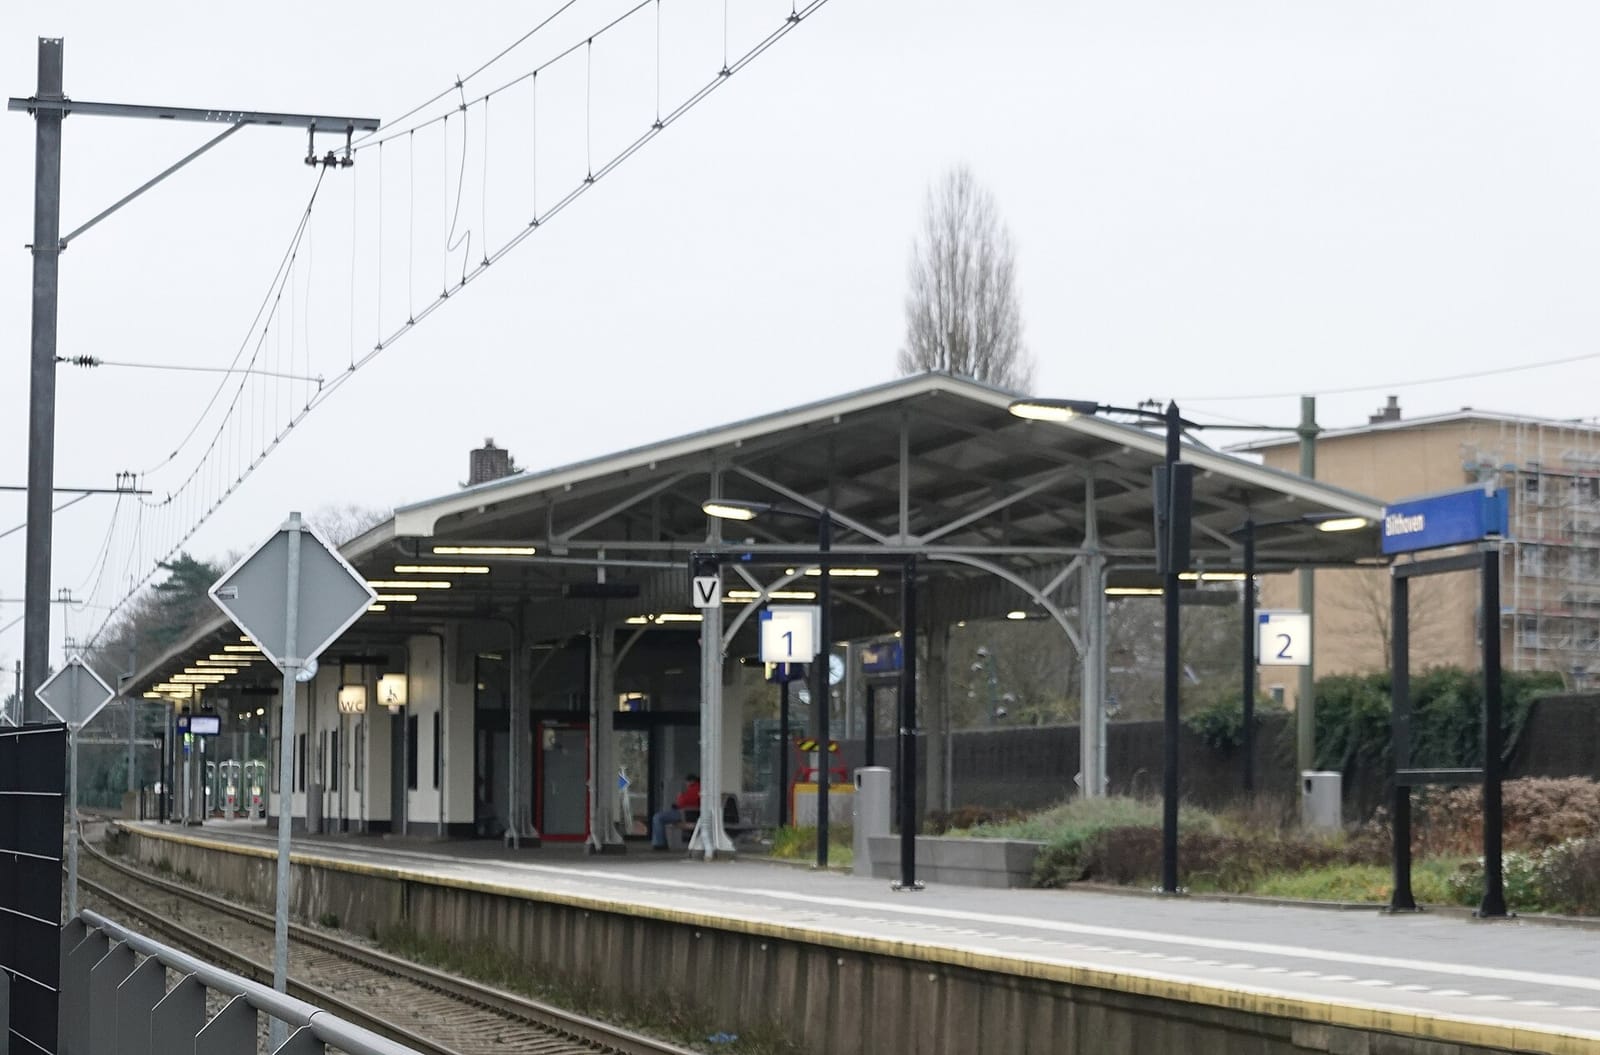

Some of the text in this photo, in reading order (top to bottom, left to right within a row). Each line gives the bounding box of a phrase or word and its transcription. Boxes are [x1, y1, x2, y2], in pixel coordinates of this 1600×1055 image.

[1385, 512, 1424, 537] Bilthoven
[696, 580, 717, 603] V
[781, 630, 792, 657] 1
[1276, 633, 1293, 659] 2
[341, 700, 363, 712] WC
